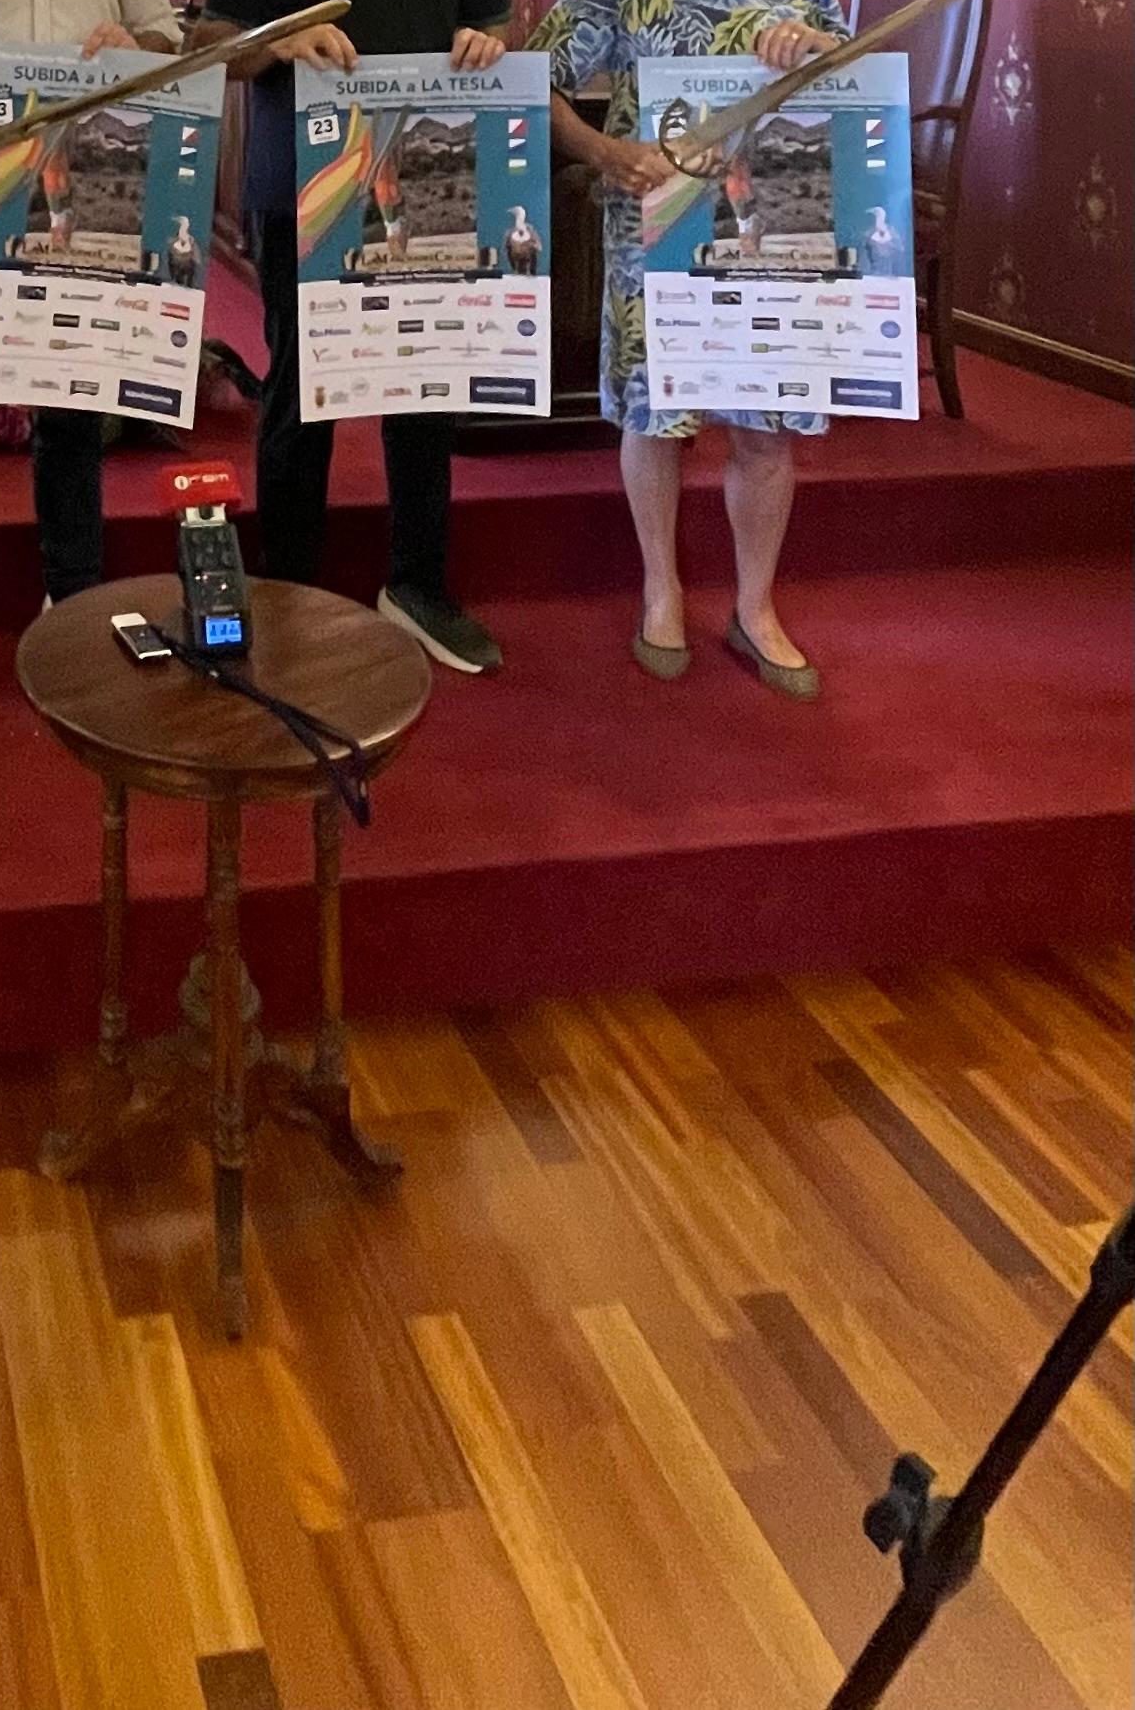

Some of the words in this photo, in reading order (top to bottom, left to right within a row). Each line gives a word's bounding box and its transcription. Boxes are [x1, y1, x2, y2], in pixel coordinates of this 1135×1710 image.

[13, 66, 79, 84] SUBIDA
[85, 74, 94, 85] a
[336, 79, 401, 95] SUBIDA
[406, 83, 416, 92] a
[422, 77, 443, 92] LA
[448, 76, 503, 91] TESLA
[682, 79, 754, 94] SUBIDA
[803, 77, 859, 92] ESLA
[314, 119, 333, 135] 23
